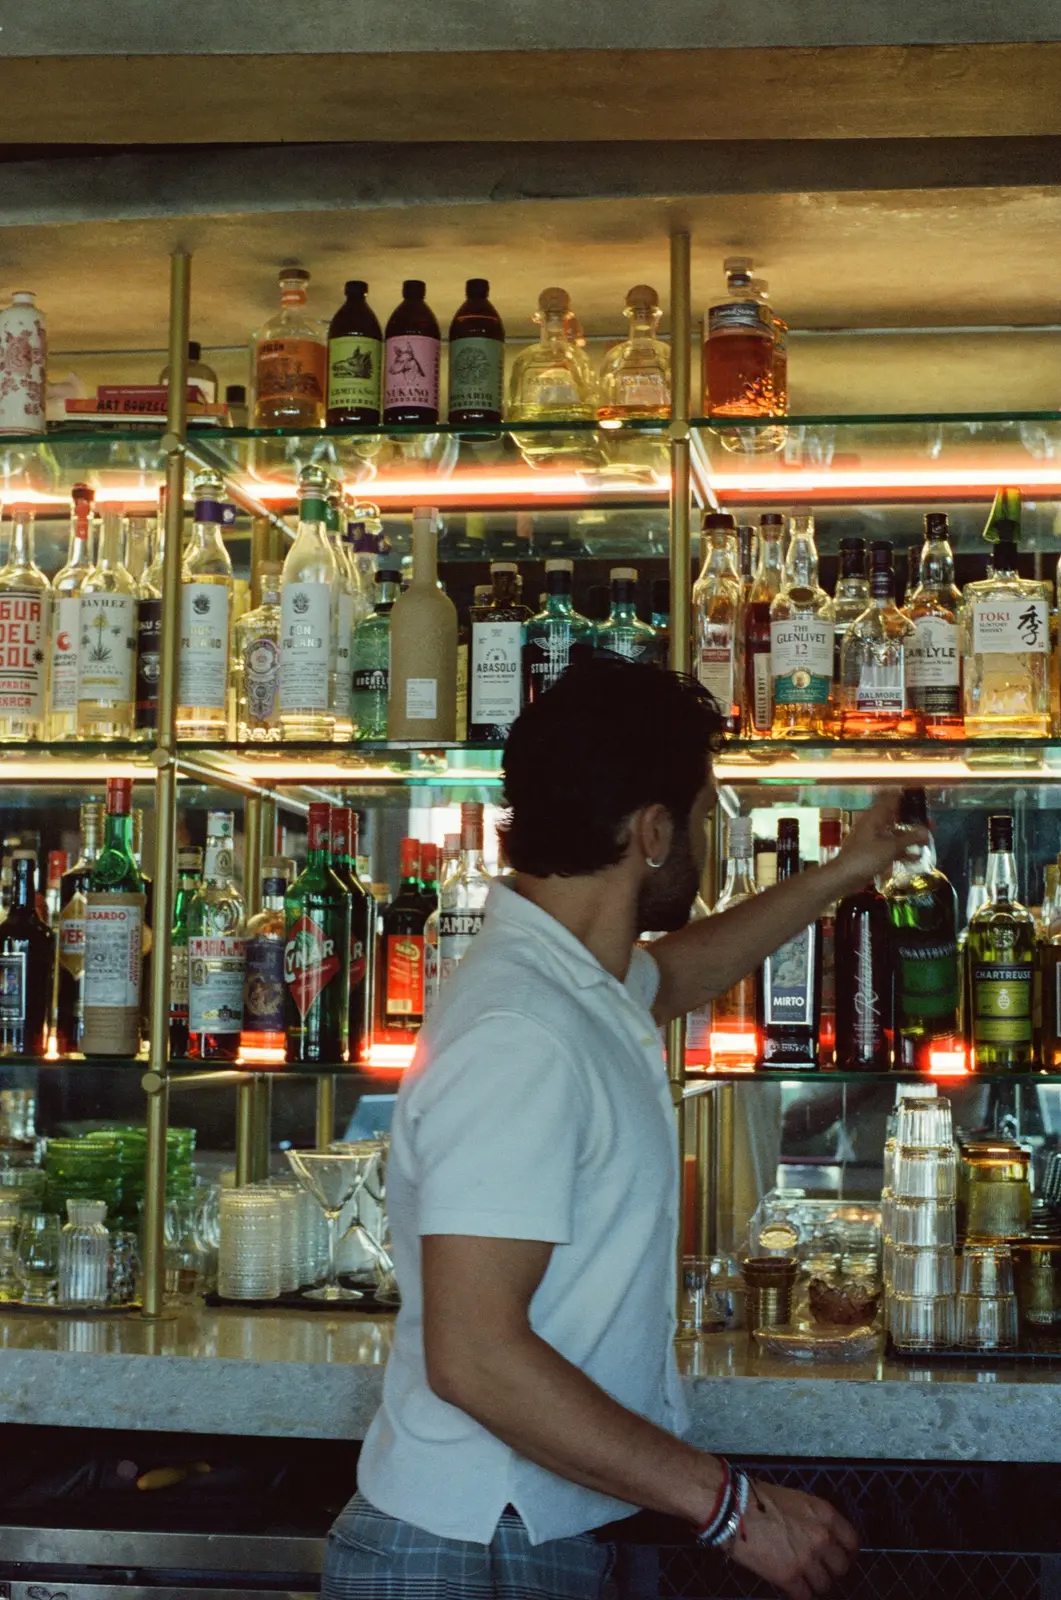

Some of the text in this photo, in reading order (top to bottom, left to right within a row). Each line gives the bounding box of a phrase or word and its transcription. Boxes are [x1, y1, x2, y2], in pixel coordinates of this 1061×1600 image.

[96, 400, 119, 411] ART
[0, 601, 41, 621] GUA
[978, 611, 1011, 621] TOKI
[794, 625, 809, 633] THE
[1017, 604, 1044, 647] 季
[777, 633, 826, 644] GLENLIVET
[795, 643, 808, 655] 12
[476, 662, 517, 673] ABASOLO
[859, 691, 901, 699] DALMORE
[438, 916, 484, 934] CAMPA
[975, 970, 1032, 980] CHARTREUSE
[772, 996, 805, 1007] MIRTO
